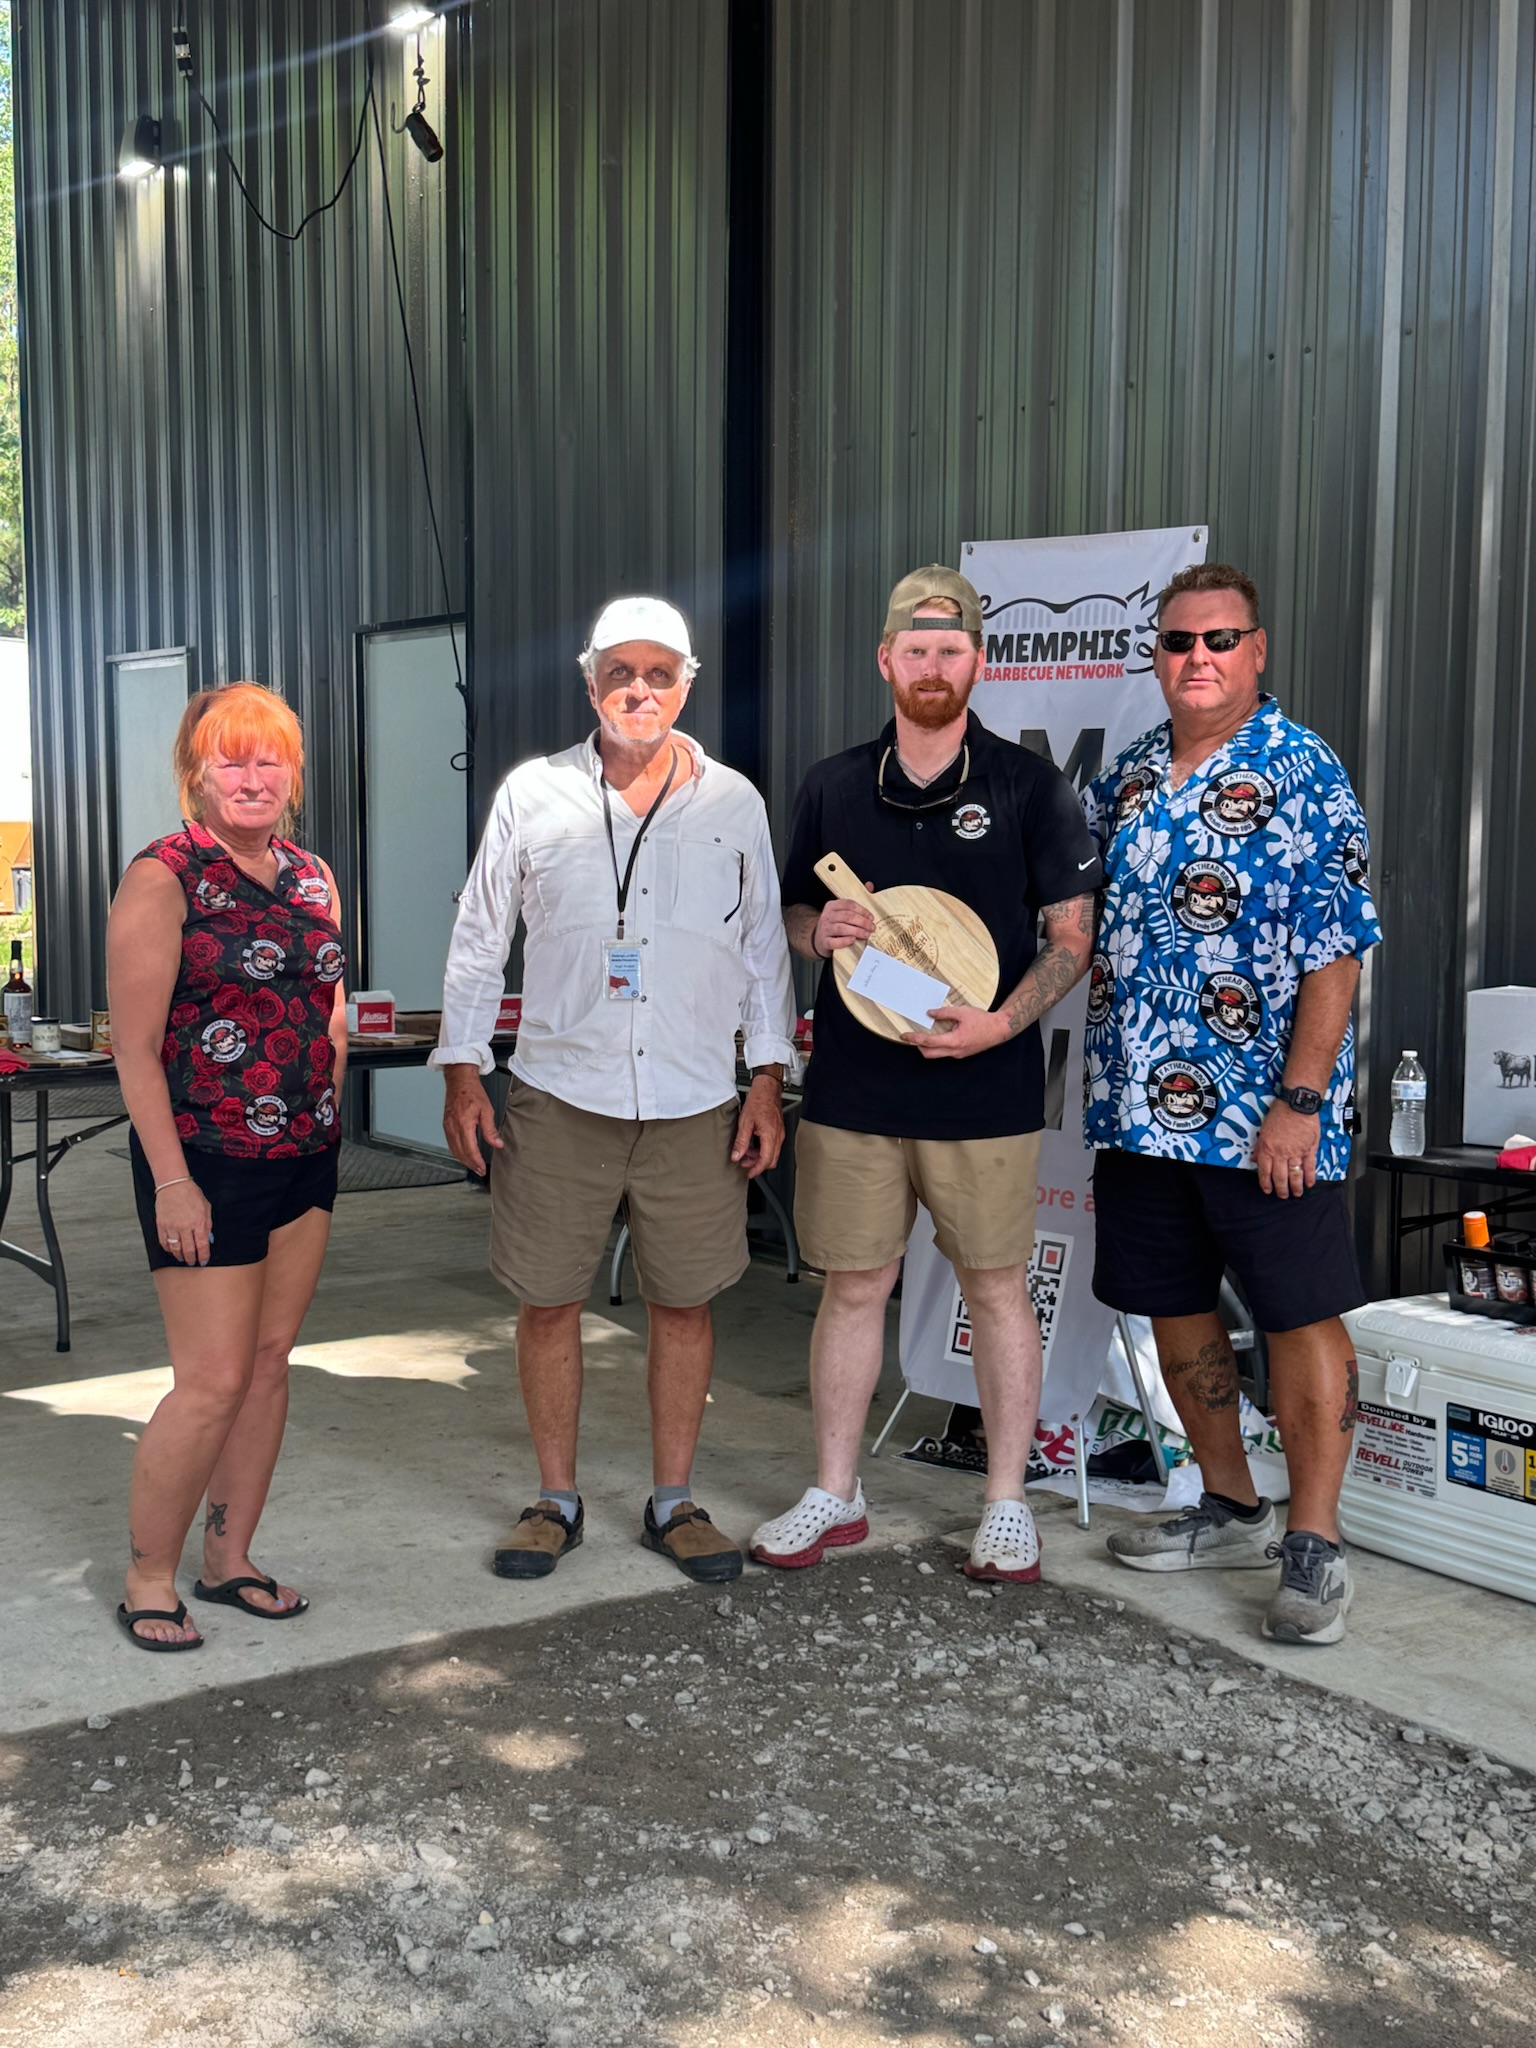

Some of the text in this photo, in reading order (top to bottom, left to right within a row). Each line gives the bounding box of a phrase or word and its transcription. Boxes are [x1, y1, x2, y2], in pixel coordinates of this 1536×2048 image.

[986, 629, 1131, 663] MEMPHIS
[984, 663, 1125, 682] BARBECUE NETWORK
[1186, 862, 1220, 876] FATHEAD
[1361, 1402, 1427, 1426] Donated by
[1478, 1412, 1534, 1437] IGLOO
[1405, 1428, 1436, 1442] Hardware
[1356, 1446, 1401, 1470] REVELL
[1451, 1440, 1468, 1467] 5
[1402, 1460, 1434, 1473] OUTDOOR
[1402, 1466, 1424, 1477] POWER
